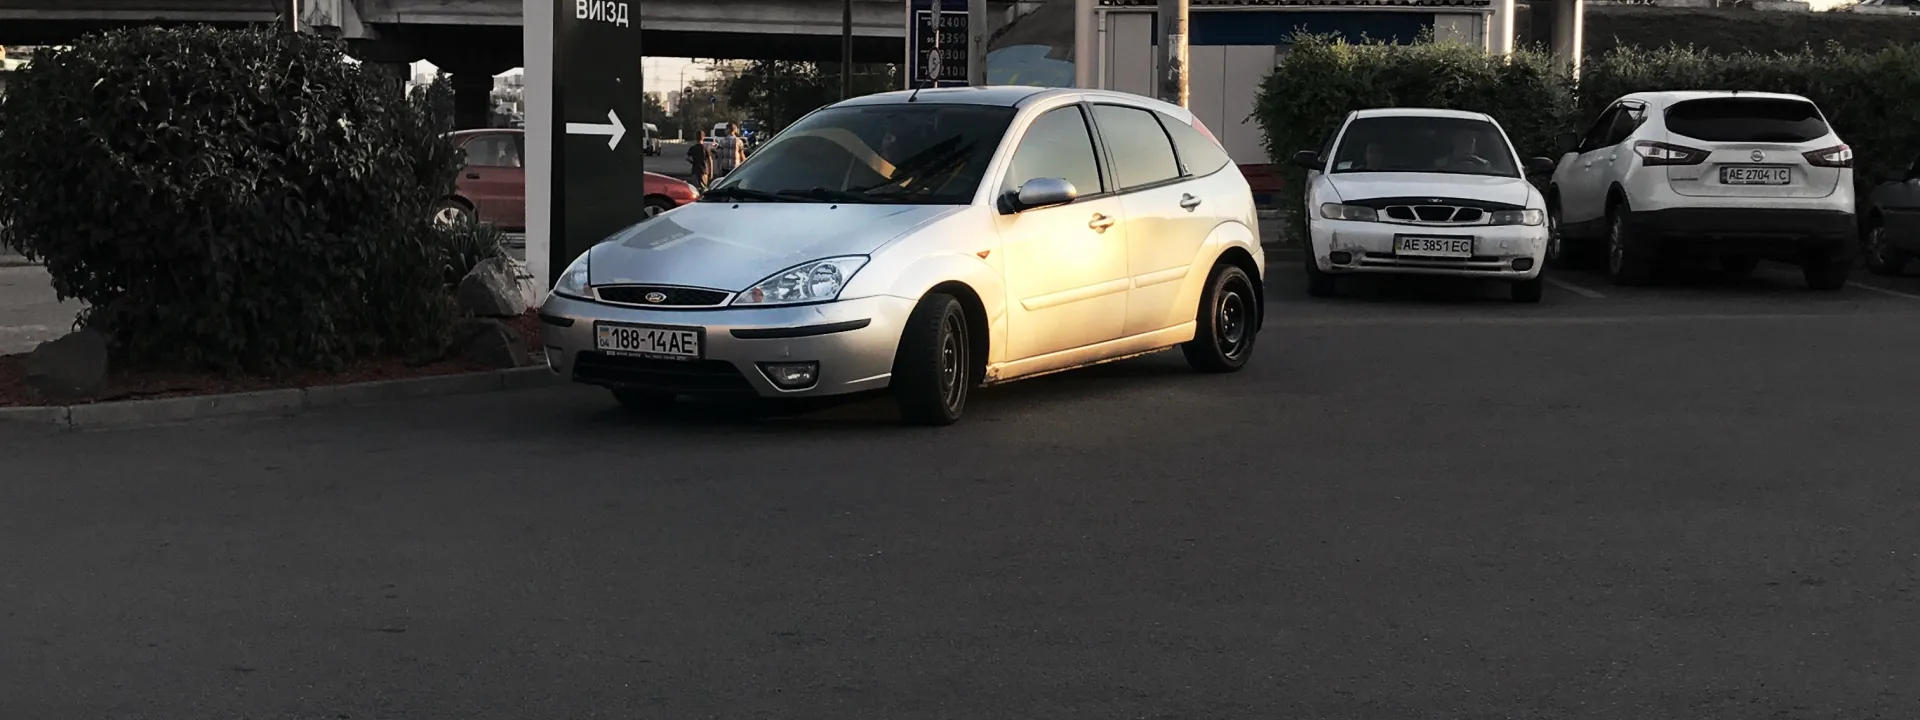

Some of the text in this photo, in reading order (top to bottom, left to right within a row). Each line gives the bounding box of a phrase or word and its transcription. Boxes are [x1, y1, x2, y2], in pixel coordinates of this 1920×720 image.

[940, 17, 967, 27] 2400
[940, 33, 966, 43] 2350
[1729, 169, 1744, 179] AE
[1746, 169, 1770, 180] 2704
[1403, 239, 1469, 252] AE 3851 EC
[612, 328, 693, 353] 188-14AE
